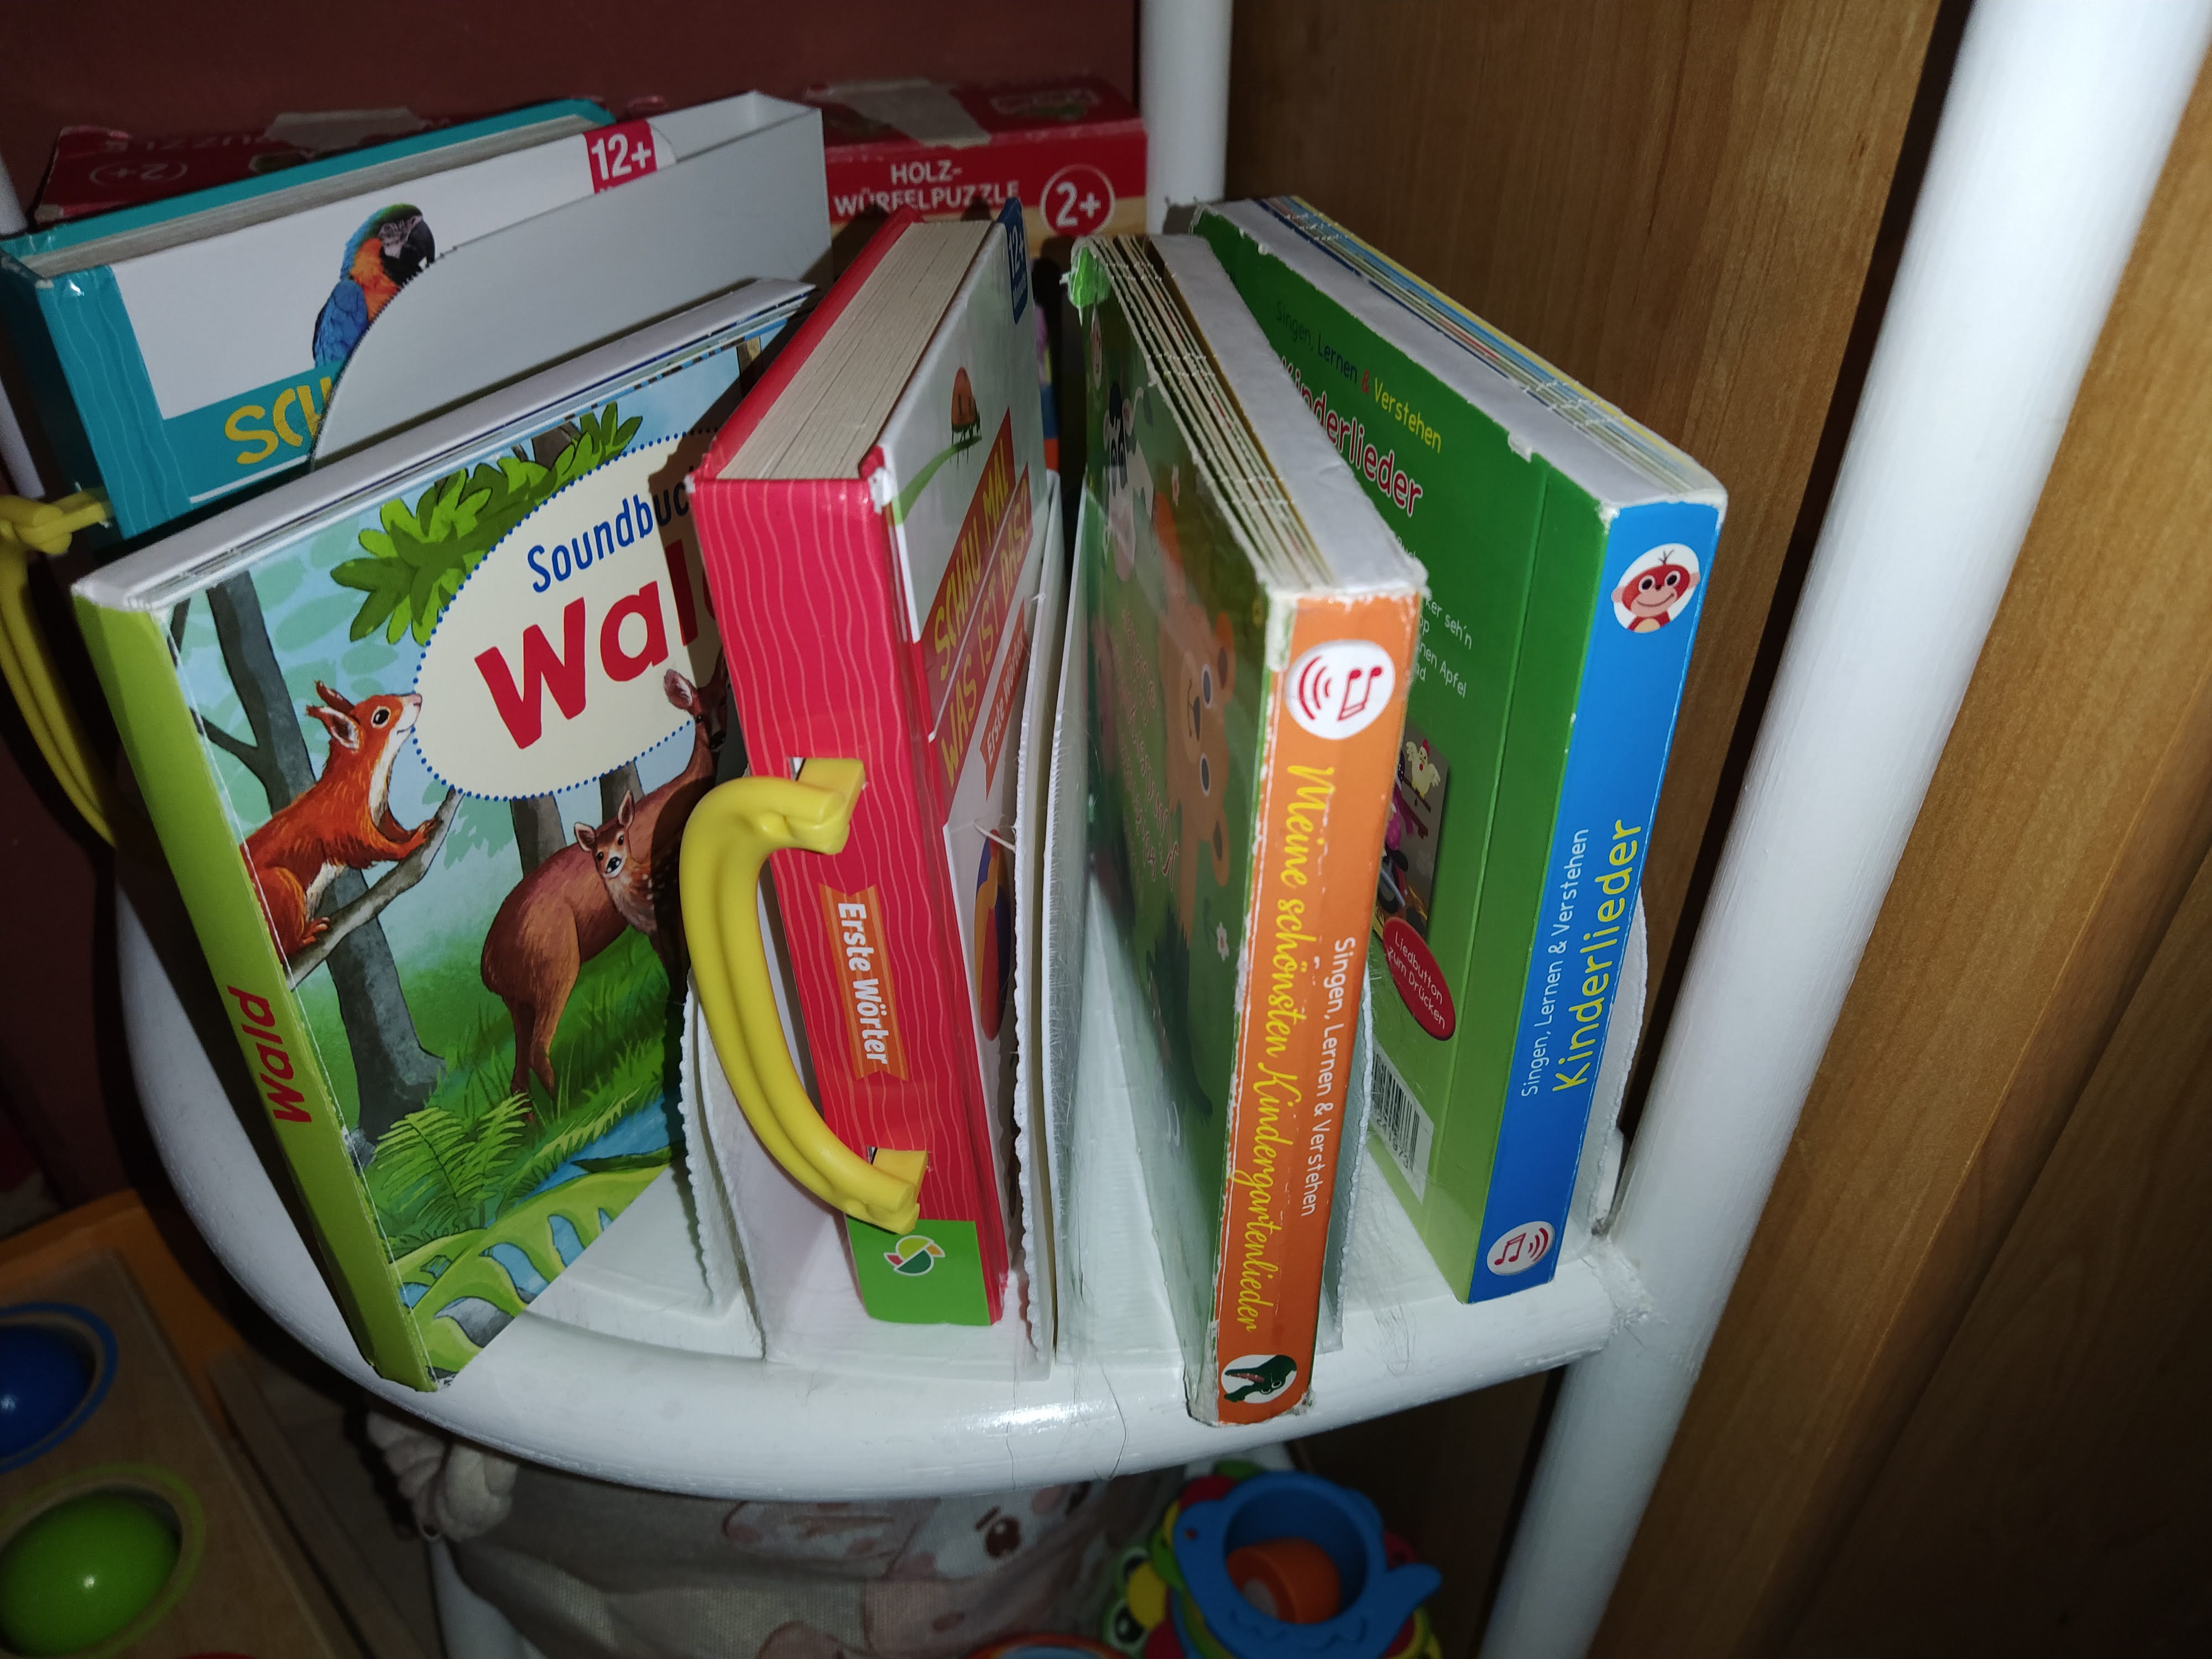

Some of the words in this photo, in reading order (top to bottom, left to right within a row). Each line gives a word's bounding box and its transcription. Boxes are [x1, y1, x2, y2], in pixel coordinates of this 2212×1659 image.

[591, 134, 653, 181] 12+
[890, 160, 962, 184] HOLZ-
[1056, 182, 1101, 227] 2+
[1276, 301, 1314, 352] Singen,
[1318, 334, 1358, 385] Lernen
[1360, 369, 1370, 395] &
[1374, 377, 1442, 453] Verstehen
[527, 466, 692, 593] Soundbuc
[934, 516, 982, 681] SCHAU
[983, 439, 1009, 546] MAL
[474, 539, 719, 750] Wal
[941, 654, 977, 788] WAS
[978, 570, 999, 679] IST
[1440, 660, 1467, 699] Apfel
[1281, 764, 1336, 890] Meine
[1551, 828, 1590, 938] Verstehen
[837, 902, 875, 972] Erste
[1265, 897, 1317, 1058] schönsten
[1323, 936, 1356, 1021] Singen,
[1395, 931, 1443, 1005] Liedbutton
[1548, 939, 1568, 955] &
[1552, 818, 1642, 1093] Kinderlieder
[852, 978, 889, 1065] Wörter
[1408, 971, 1446, 1030] Drücken
[1534, 959, 1564, 1028] Lernen
[227, 984, 312, 1123] Wald
[1315, 1022, 1345, 1097] Lernen
[1521, 1030, 1552, 1098] Singen,
[1313, 1102, 1334, 1117] &
[1230, 1062, 1302, 1334] Kindergartenlieder
[1300, 1121, 1331, 1217] Verstehen
